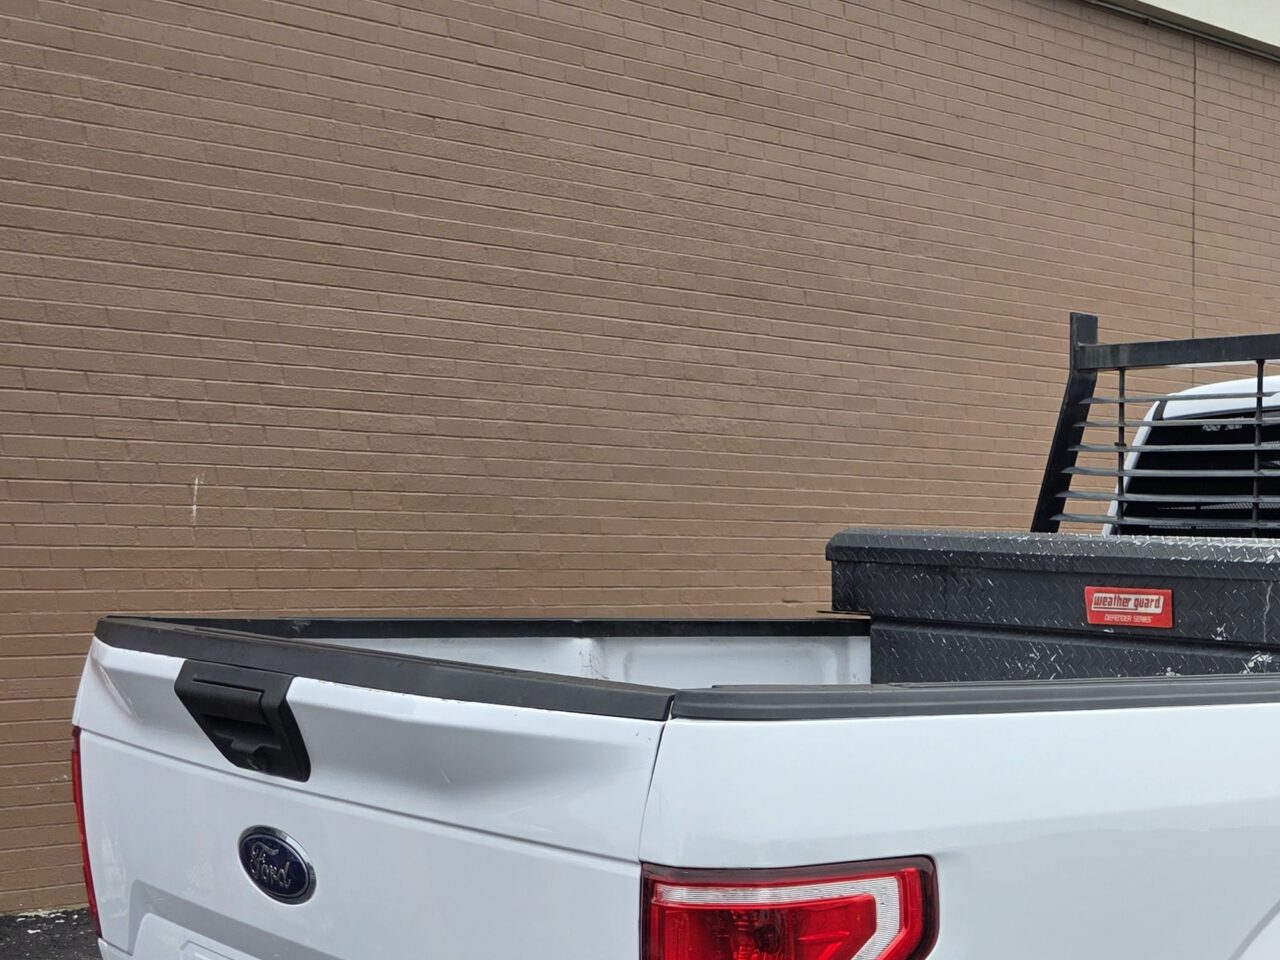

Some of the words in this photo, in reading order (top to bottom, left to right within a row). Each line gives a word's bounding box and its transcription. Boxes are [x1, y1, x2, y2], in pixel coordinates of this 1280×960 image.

[1093, 594, 1132, 607] weather
[1133, 596, 1162, 610] guard
[1104, 614, 1132, 622] DEFENDER
[1133, 615, 1153, 624] SERIES
[250, 841, 291, 889] Ford
